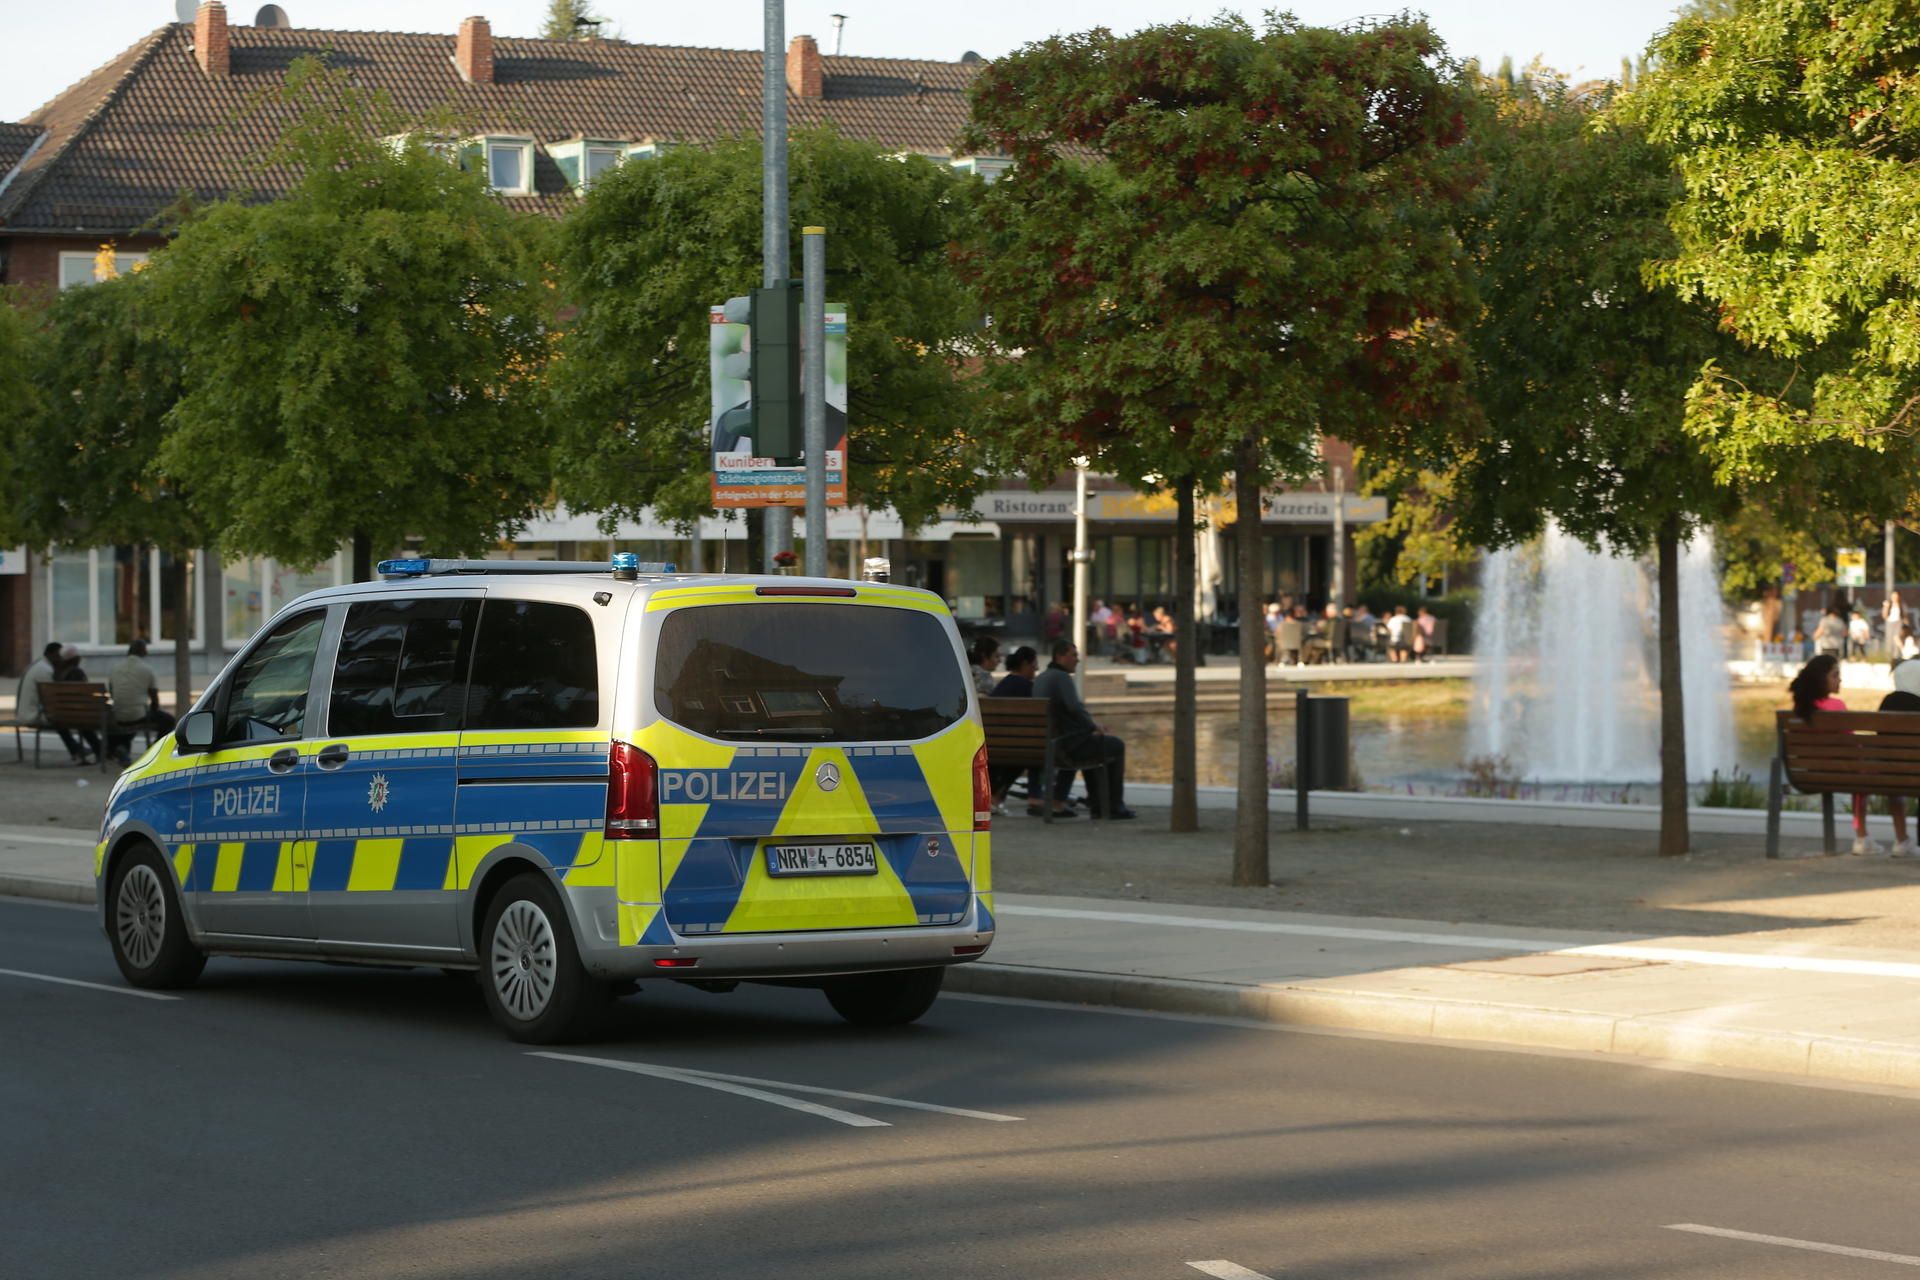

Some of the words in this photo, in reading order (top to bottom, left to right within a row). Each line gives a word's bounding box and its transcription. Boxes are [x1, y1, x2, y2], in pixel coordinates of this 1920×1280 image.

[768, 490, 783, 499] der
[1264, 501, 1329, 516] izzeria
[663, 771, 786, 801] POLIZEI
[213, 784, 280, 817] POLIZEI
[777, 847, 809, 869] NRW
[818, 845, 874, 868] 4-6854
